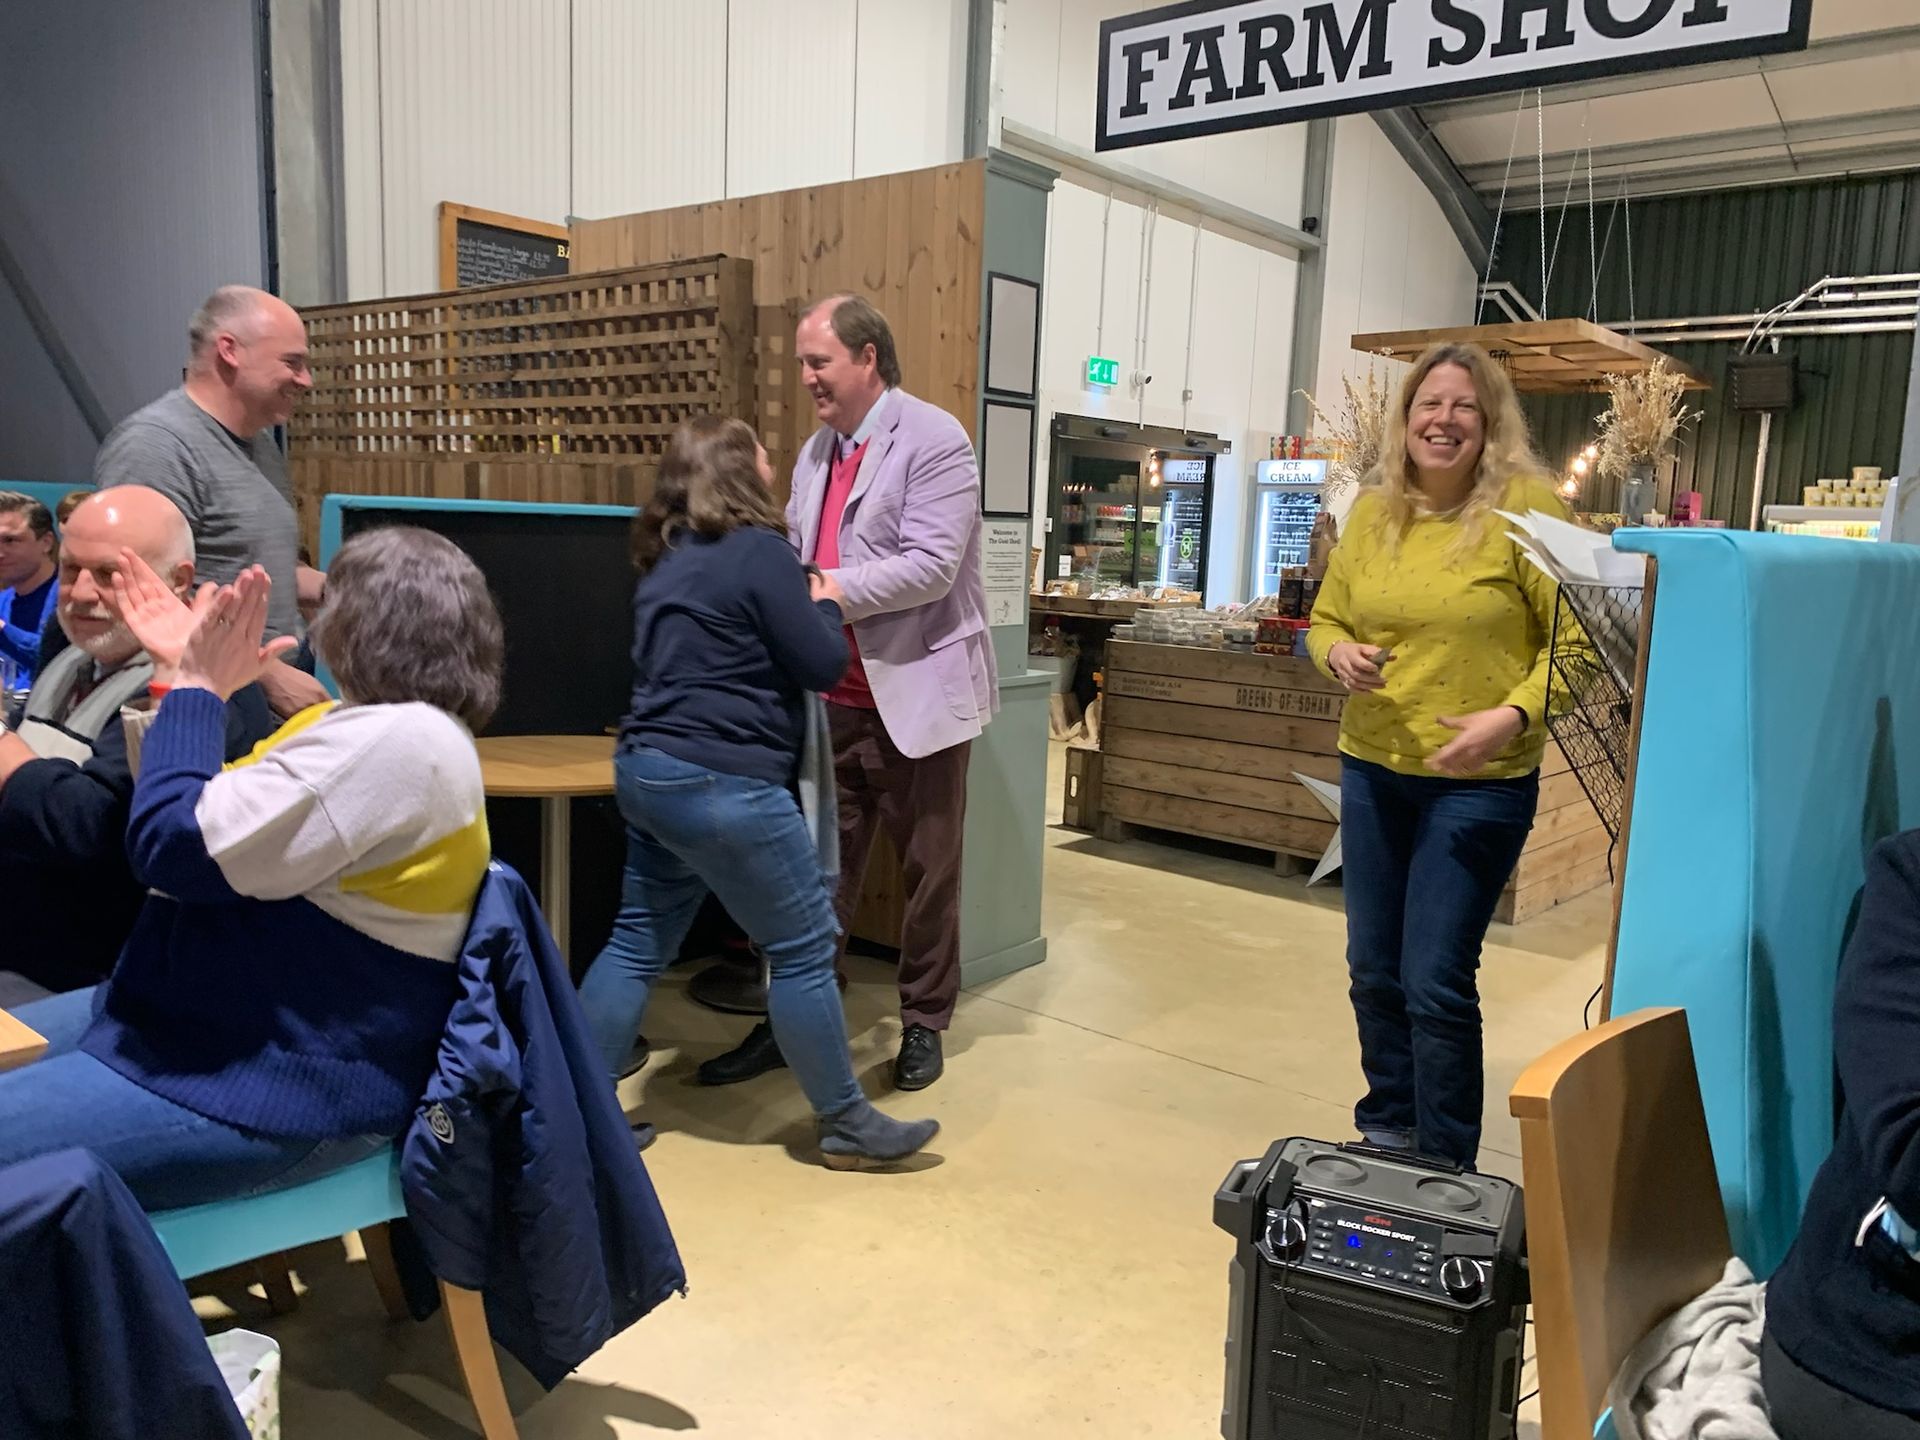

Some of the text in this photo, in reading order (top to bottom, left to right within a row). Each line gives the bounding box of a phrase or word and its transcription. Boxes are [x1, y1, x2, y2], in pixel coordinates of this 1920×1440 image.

[1119, 0, 1393, 118] FARM
[1270, 472, 1312, 482] CREAM
[1282, 461, 1301, 471] ICE
[1236, 688, 1272, 709] GREENS
[1299, 695, 1331, 716] SOHAM
[1337, 1219, 1416, 1242] BLOCK ROCKER SPORT
